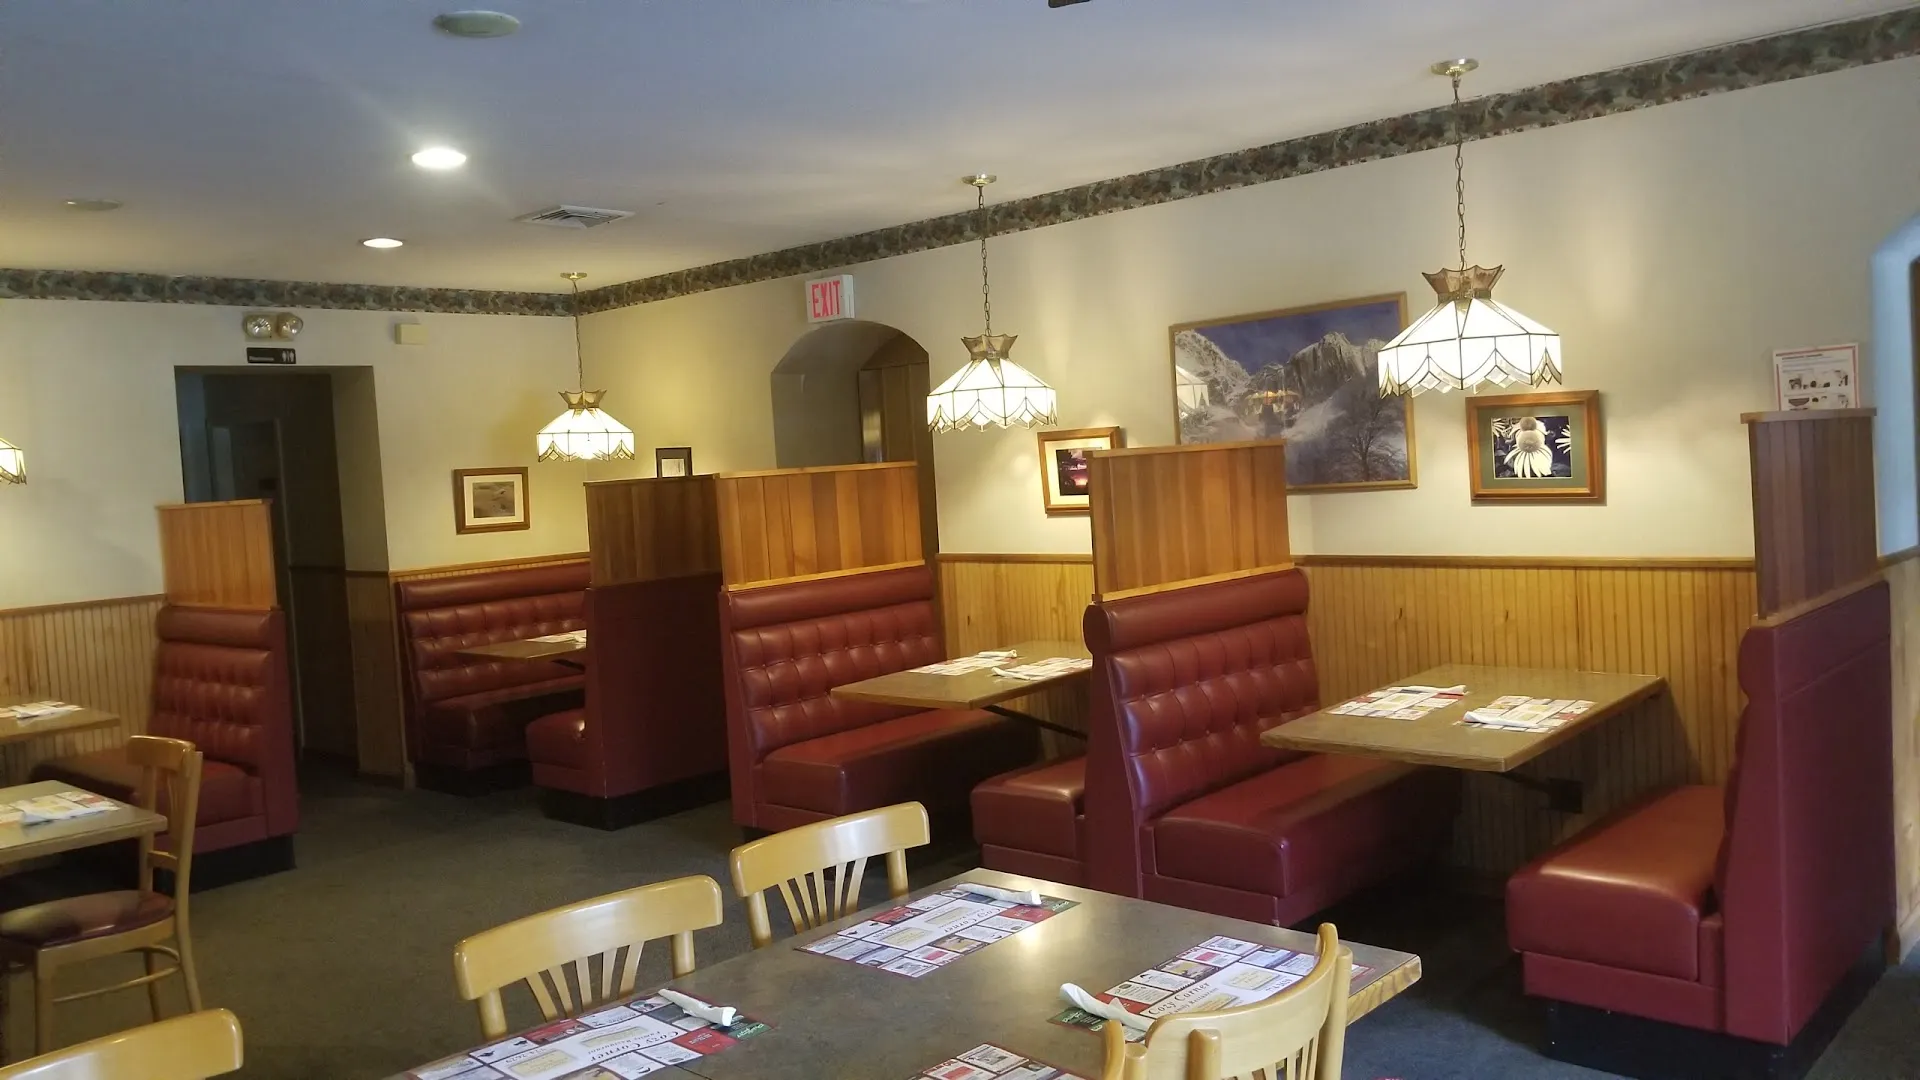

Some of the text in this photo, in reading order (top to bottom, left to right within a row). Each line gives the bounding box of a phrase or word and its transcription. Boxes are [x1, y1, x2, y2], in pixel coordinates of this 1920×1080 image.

[811, 280, 841, 319] EXIT
[943, 918, 977, 933] Corner
[1148, 982, 1211, 1015] Cozy Corner
[645, 1031, 679, 1044] Cozy
[590, 1043, 641, 1062] Corner
